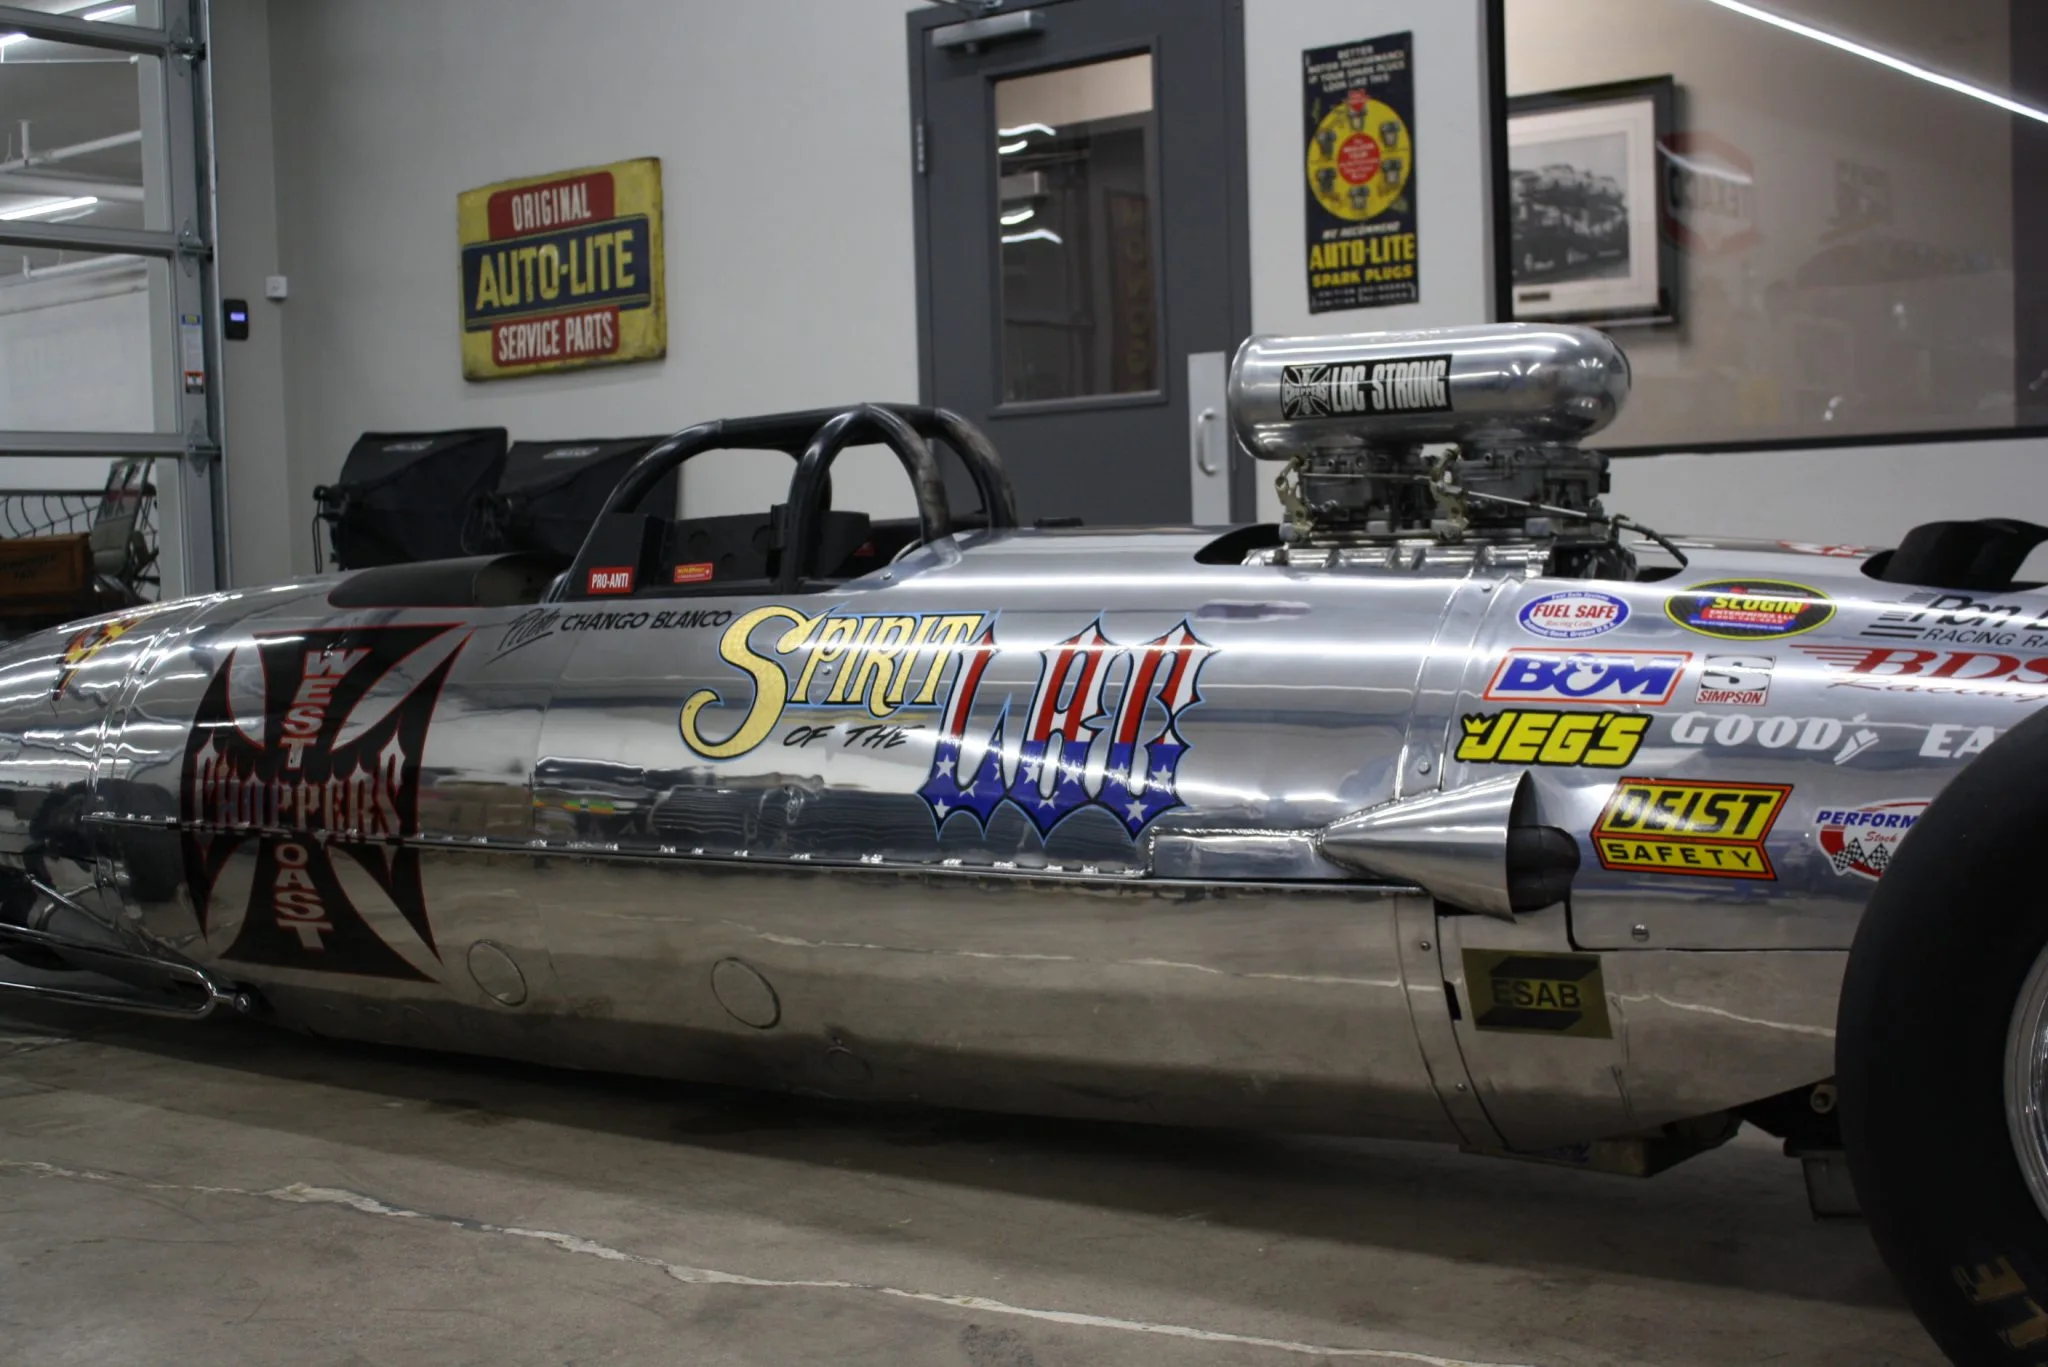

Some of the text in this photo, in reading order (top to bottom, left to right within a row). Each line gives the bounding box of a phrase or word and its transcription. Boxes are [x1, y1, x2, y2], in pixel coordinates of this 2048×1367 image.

[511, 182, 592, 232] ORIGINAL
[1310, 232, 1415, 271] AUTO-LITE
[475, 229, 635, 311] AUTO-LITE
[1312, 263, 1413, 288] SPARK PLUGS
[499, 311, 613, 362] SERVICE PARTS
[1371, 359, 1448, 412] STRONG
[591, 572, 629, 589] PRO-ANTI
[1533, 604, 1618, 619] FUEL SAFE
[1712, 596, 1802, 614] SCOGIN
[560, 609, 733, 632] CHANGO BLANCO
[1923, 628, 2017, 646] RACING
[1496, 653, 1684, 697] B&M
[281, 649, 371, 771] WEST
[1698, 690, 1763, 705] SIMPSON
[783, 725, 925, 749] OF THE
[1456, 711, 1650, 767] JEG'S
[1608, 788, 1773, 835] DEIST
[1865, 831, 1898, 843] Stock
[1606, 843, 1753, 867] SAFETY
[1491, 979, 1582, 1009] ESAB
